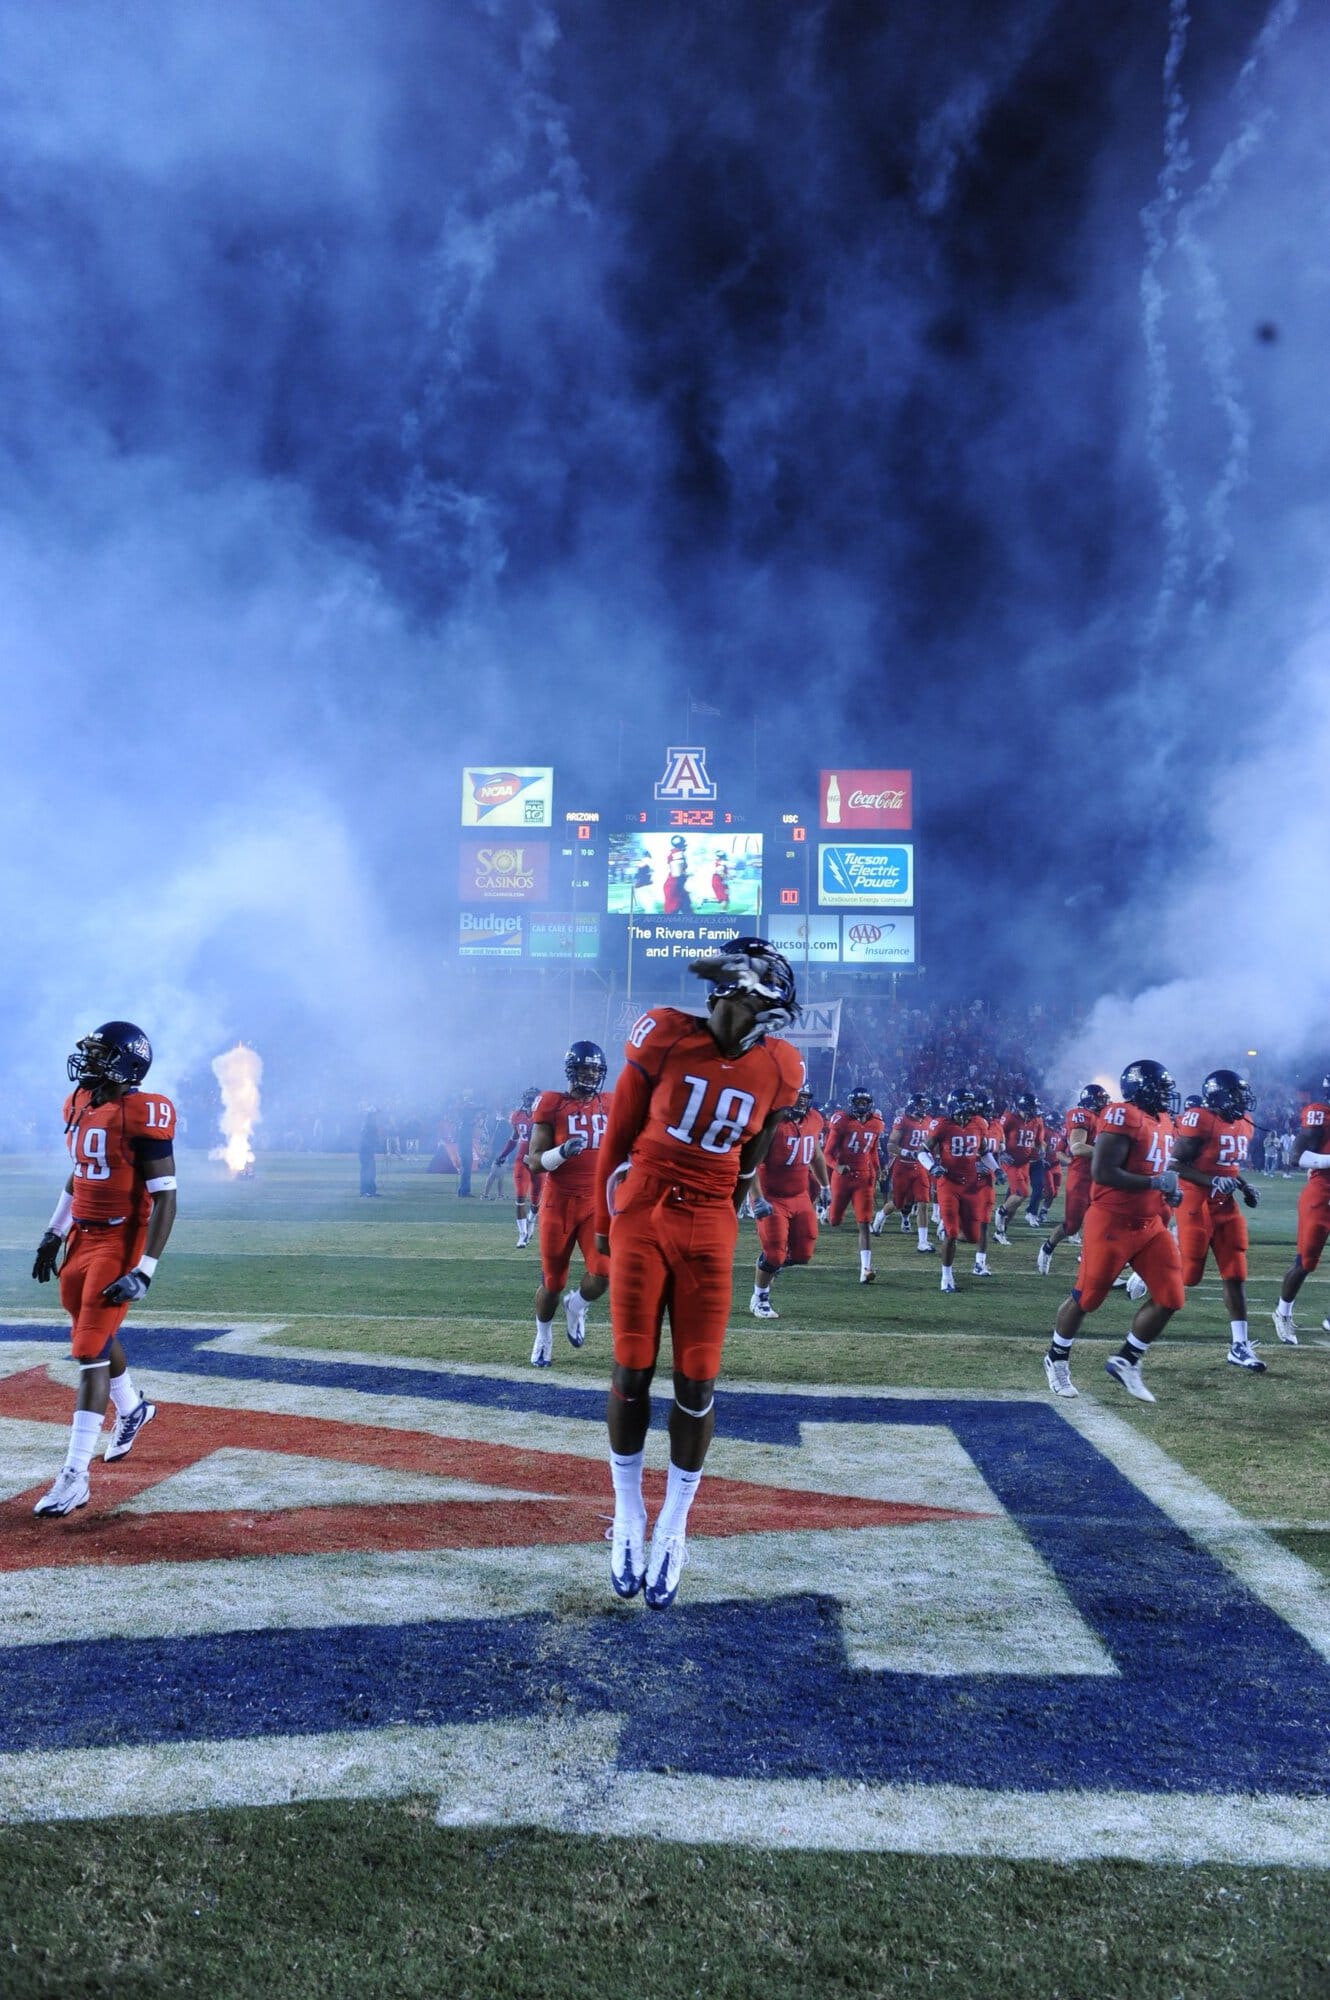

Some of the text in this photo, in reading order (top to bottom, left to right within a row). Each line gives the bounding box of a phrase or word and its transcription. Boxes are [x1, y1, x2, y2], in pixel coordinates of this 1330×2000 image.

[654, 746, 718, 801] A
[480, 785, 513, 798] NCAA
[848, 790, 906, 809] Coca-Cola
[566, 812, 600, 822] ARIZONA
[639, 812, 647, 823] 3
[669, 809, 715, 826] 3:22
[724, 813, 733, 823] 3
[782, 813, 799, 824] USC
[578, 825, 590, 840] 0
[792, 827, 806, 841] 0
[475, 847, 534, 877] SOL
[844, 852, 889, 865] Tucson
[848, 865, 900, 877] Electric
[475, 876, 534, 889] CASINOS
[854, 876, 900, 888] Power
[460, 912, 523, 936] Budget
[568, 925, 598, 933] CNTERS
[628, 927, 740, 941] The Rivera Family
[850, 924, 881, 944] AAA
[646, 946, 669, 958] and
[865, 947, 910, 956] Insurance
[145, 1101, 172, 1129] 19
[666, 1074, 755, 1154] 18
[1071, 1112, 1085, 1123] 45
[1103, 1105, 1127, 1127] 46
[1181, 1111, 1200, 1128] 28
[1306, 1110, 1325, 1126] 83
[567, 1113, 608, 1150] 58
[1016, 1129, 1034, 1148] 12
[785, 1135, 815, 1166] 70
[847, 1131, 874, 1154] 47
[951, 1135, 977, 1157] 82
[1215, 1135, 1248, 1167] 28
[69, 1125, 111, 1180] 19
[1145, 1131, 1174, 1172] 46
